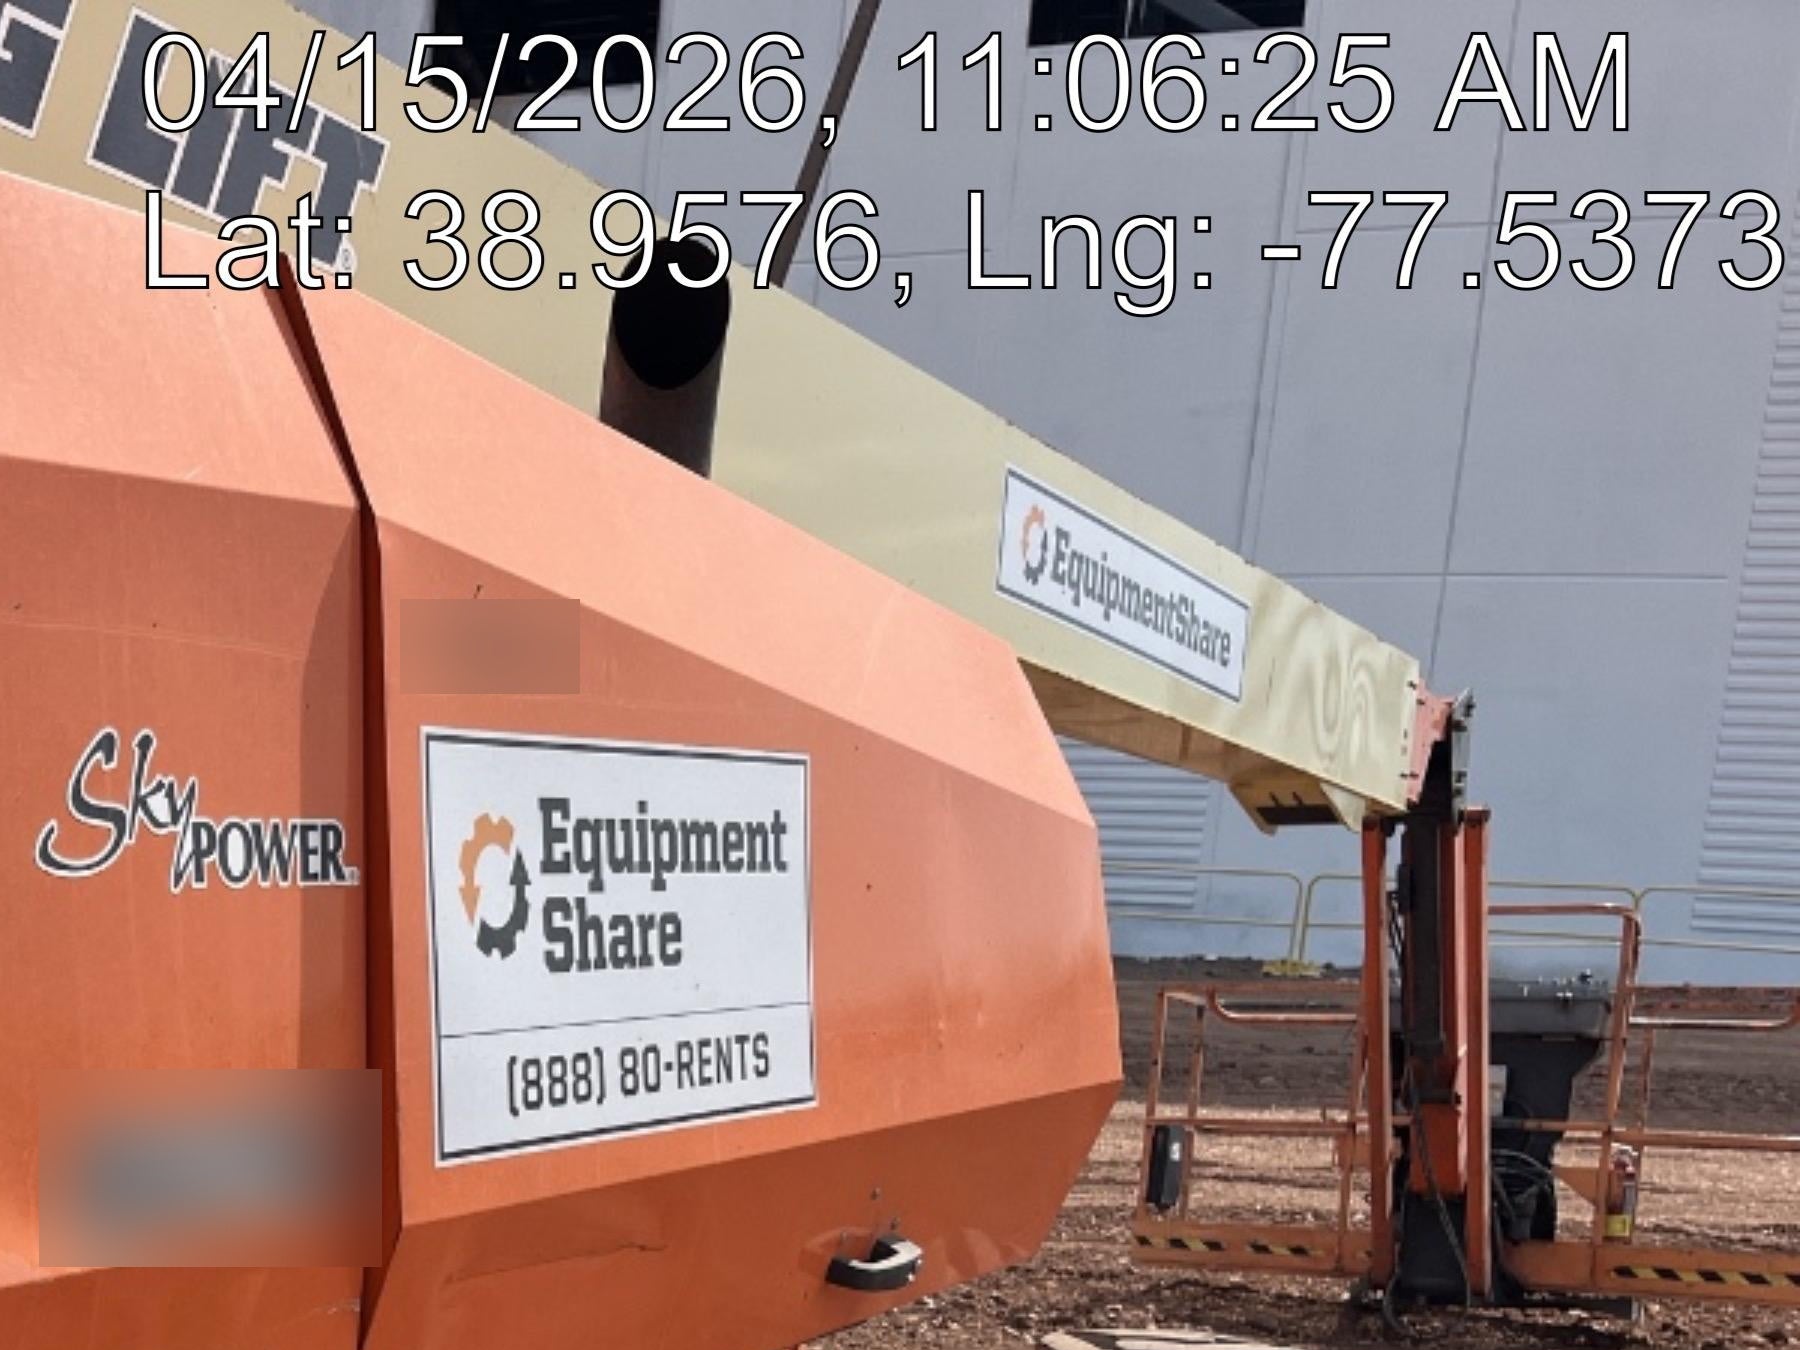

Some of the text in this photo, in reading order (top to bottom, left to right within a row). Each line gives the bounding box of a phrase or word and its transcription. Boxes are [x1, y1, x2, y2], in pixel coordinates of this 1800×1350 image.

[86, 6, 390, 278] LIFT
[1050, 526, 1232, 668] EquipmentShare
[538, 796, 788, 893] Equipment
[541, 896, 683, 973] Share
[507, 1031, 771, 1117] (888) 80-RENTS
